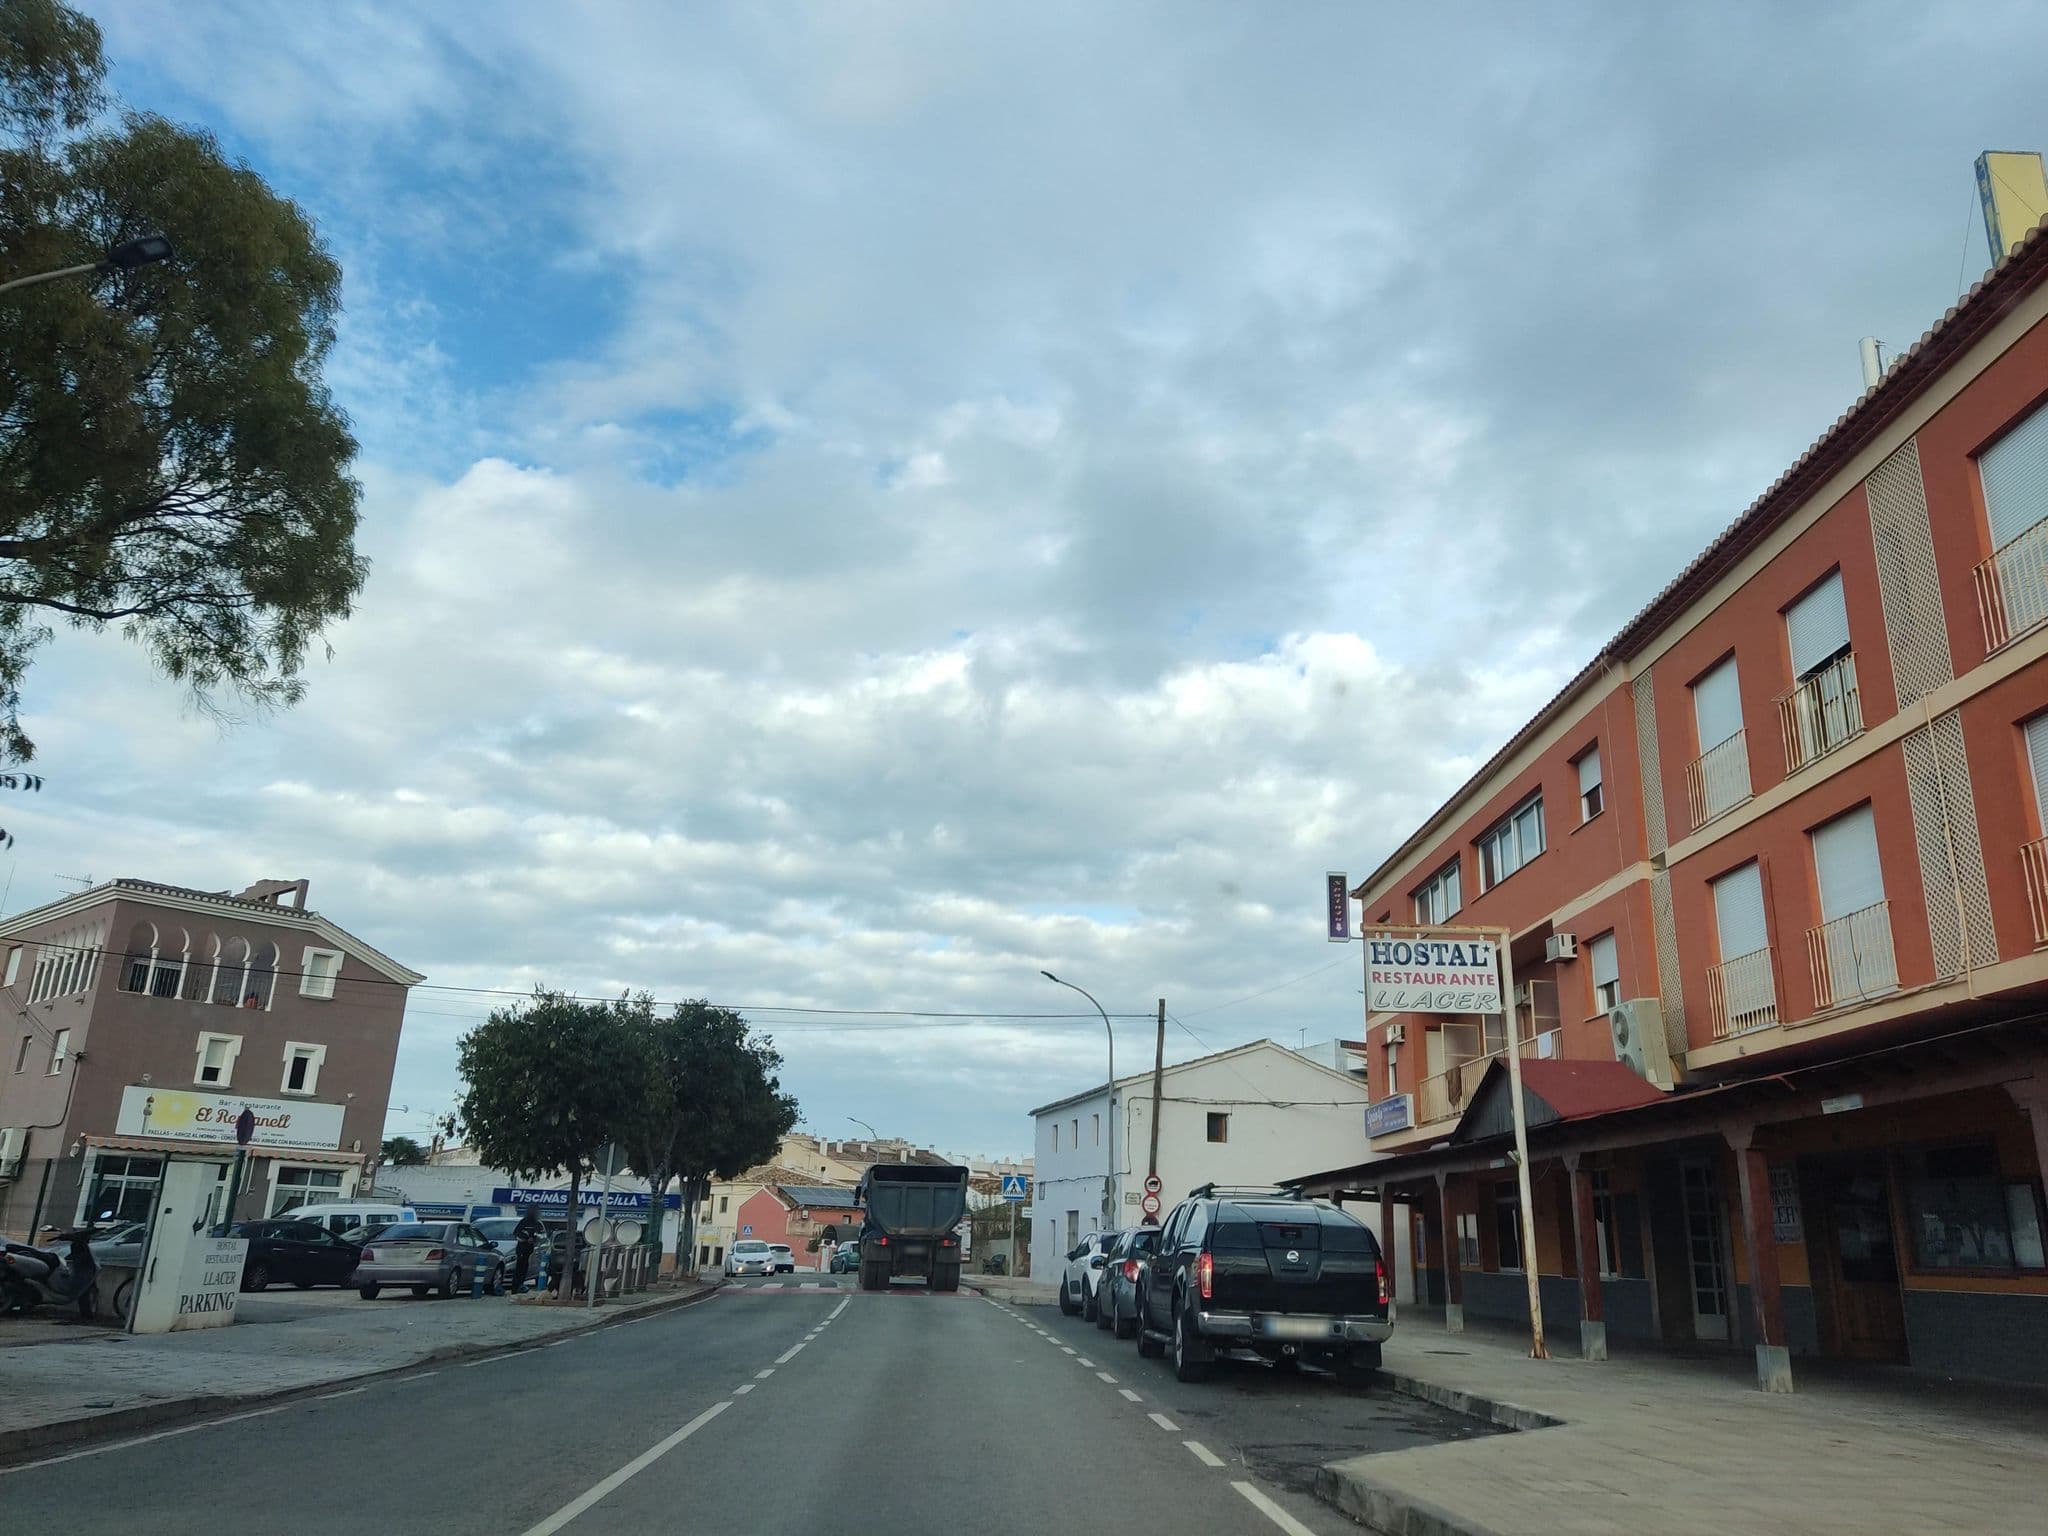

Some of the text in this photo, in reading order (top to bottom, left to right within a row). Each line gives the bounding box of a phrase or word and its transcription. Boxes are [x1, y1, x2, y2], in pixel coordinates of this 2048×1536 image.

[1371, 942, 1488, 967] HOSTAL
[1372, 971, 1495, 986] RESTAURANTE
[1373, 990, 1497, 1010] LLACER
[203, 1271, 236, 1285] LLACER
[179, 1292, 235, 1314] PARKING
